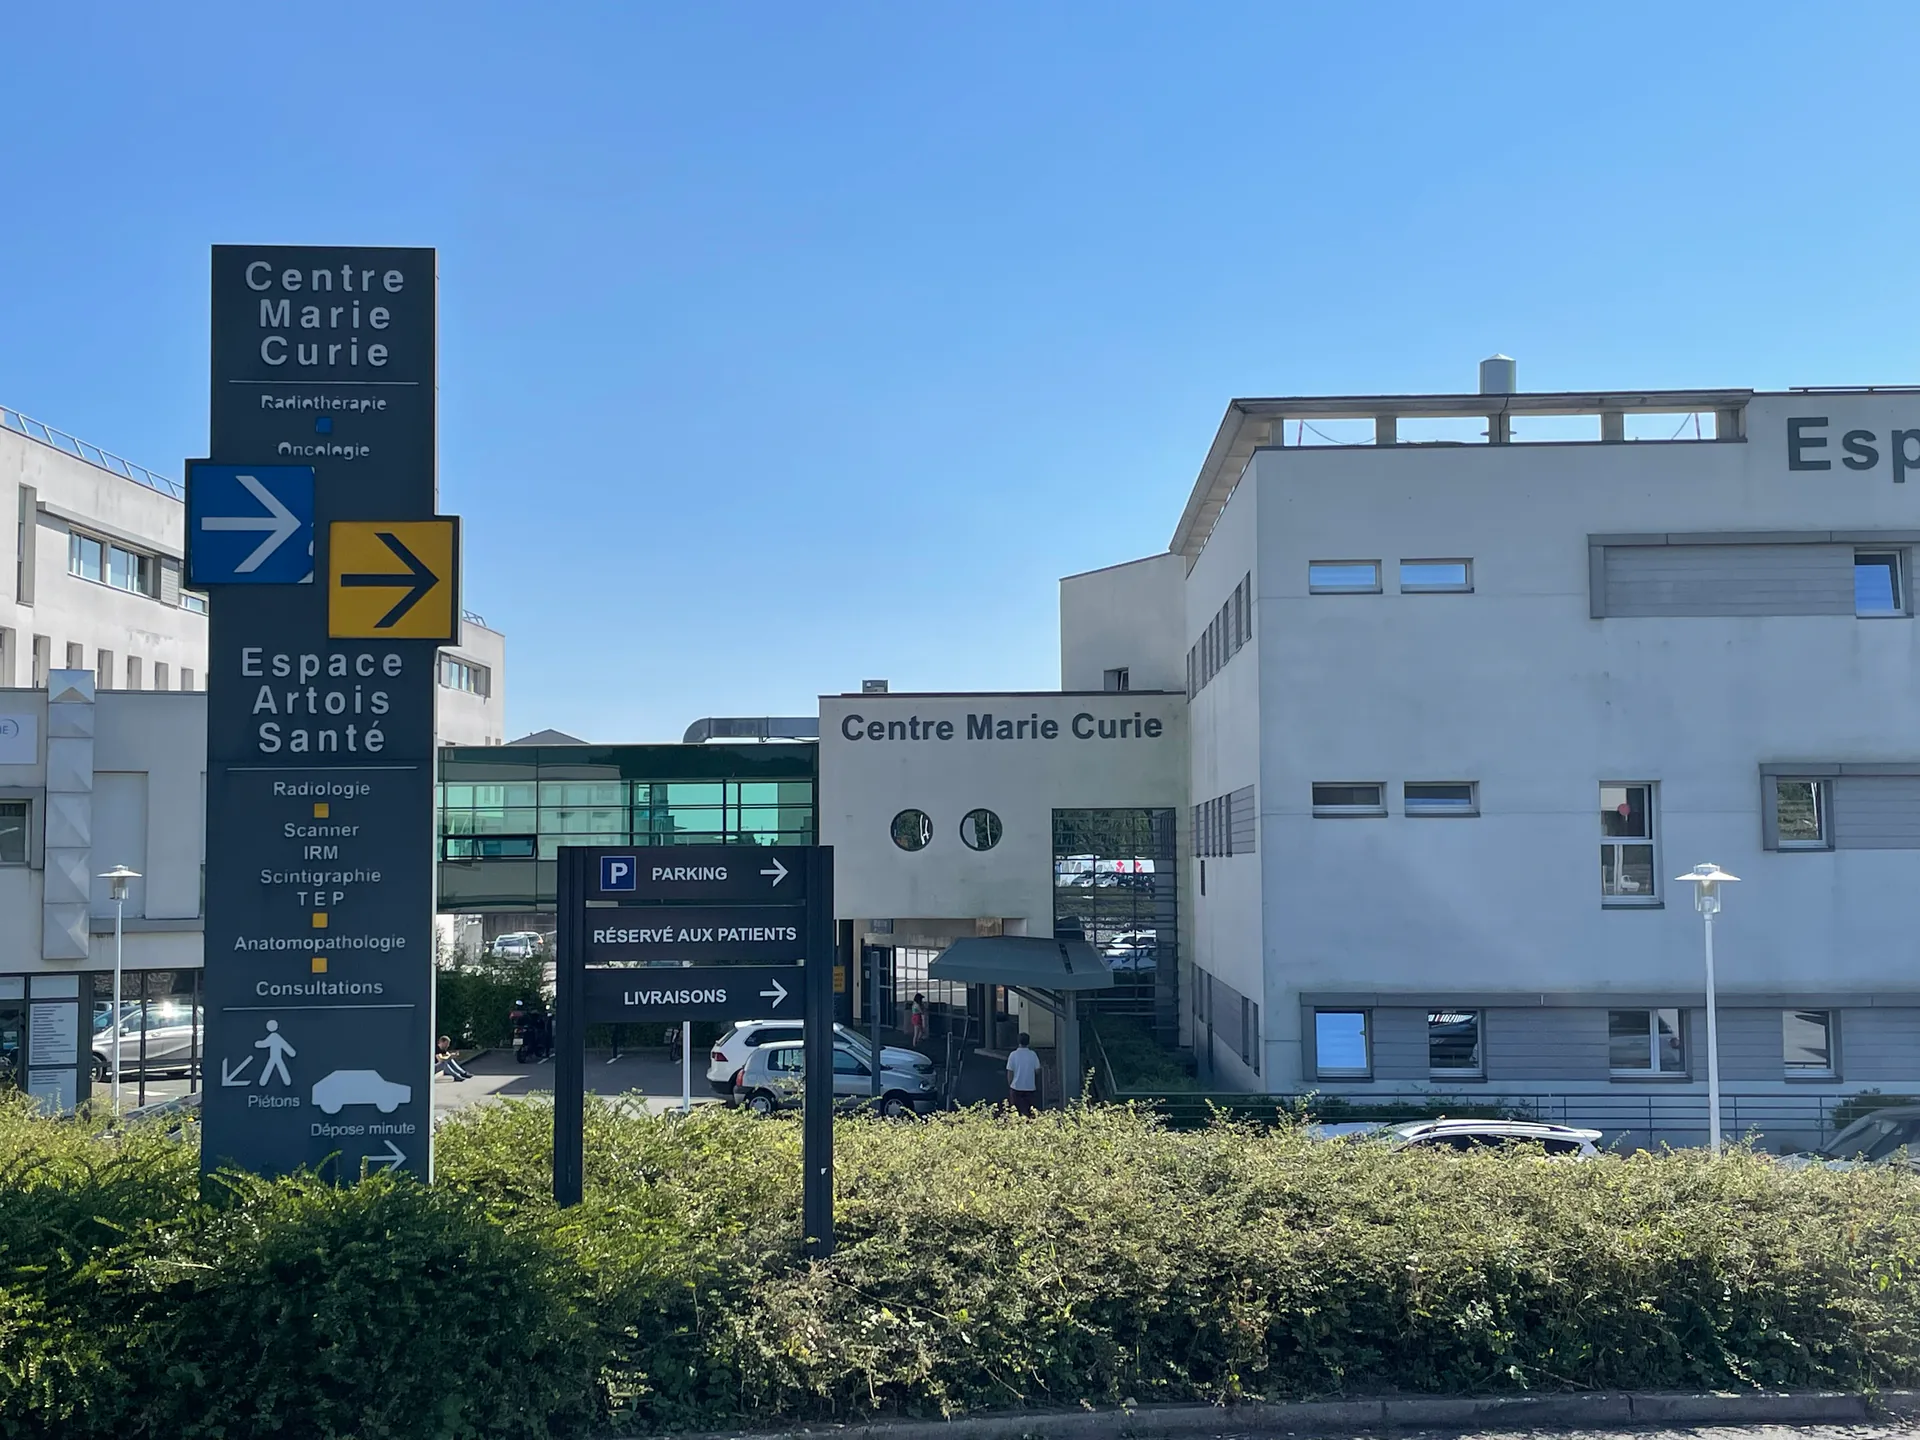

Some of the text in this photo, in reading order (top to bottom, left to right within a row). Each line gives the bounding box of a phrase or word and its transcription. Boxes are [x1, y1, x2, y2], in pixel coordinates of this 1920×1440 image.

[246, 261, 403, 292] Centre
[260, 298, 391, 330] Marie
[260, 336, 389, 367] Curie
[278, 442, 369, 459] Oncologie
[1787, 417, 1920, 483] Esp
[242, 647, 402, 685] Espace
[253, 685, 389, 714] Artois
[842, 712, 1162, 740] Centre Marie Curie
[259, 721, 384, 752] Santé
[274, 782, 370, 798] Radiologie
[285, 823, 359, 837] Scanner
[305, 846, 337, 859] IRM
[261, 869, 380, 886] Scintigraphie
[611, 863, 627, 884] P
[653, 867, 727, 880] PARKING
[594, 926, 796, 943] RÉSERVÉ AUX PATIENTS
[235, 935, 405, 952] Anatomopathologie
[257, 981, 382, 995] Consultations
[625, 989, 726, 1004] LIVRAISONS
[249, 1095, 299, 1107] Piétons
[312, 1122, 415, 1137] Dépose minute
